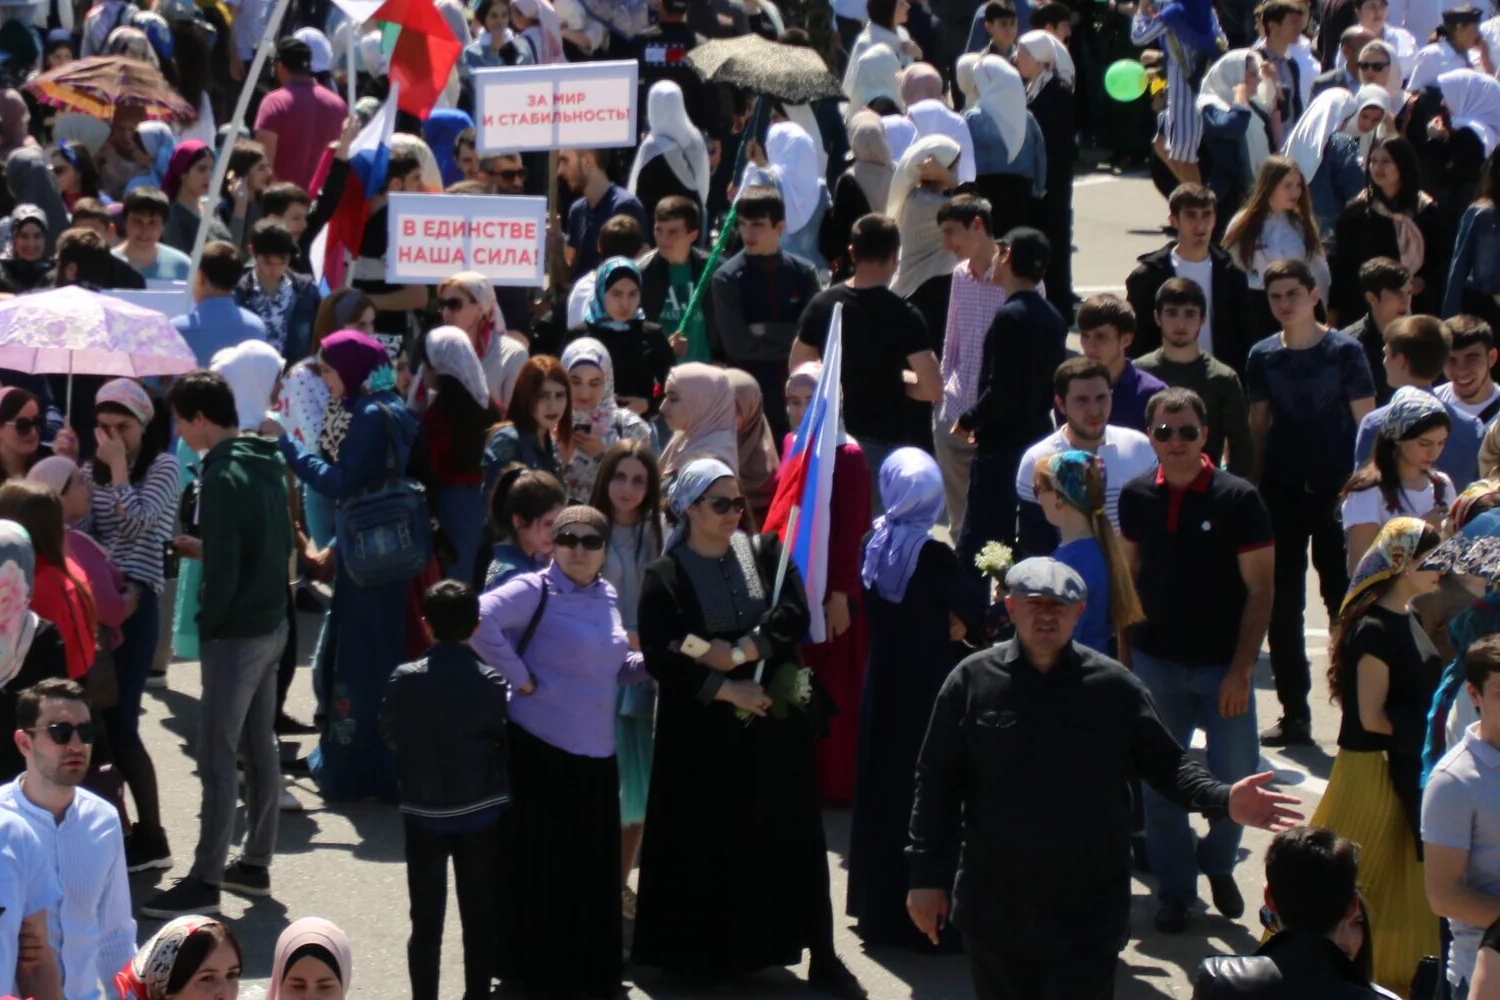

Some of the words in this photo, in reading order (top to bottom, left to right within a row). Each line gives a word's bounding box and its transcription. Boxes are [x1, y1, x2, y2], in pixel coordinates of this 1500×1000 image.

[527, 94, 548, 107] ЗА
[553, 92, 586, 105] МИР
[483, 115, 493, 127] И
[499, 108, 631, 127] СТАБИЛЬНОСТЬ!
[403, 219, 416, 236] В
[424, 220, 536, 241] ЕДИНСТВЕ
[399, 246, 465, 264] НАША
[473, 246, 539, 267] СИЛА!
